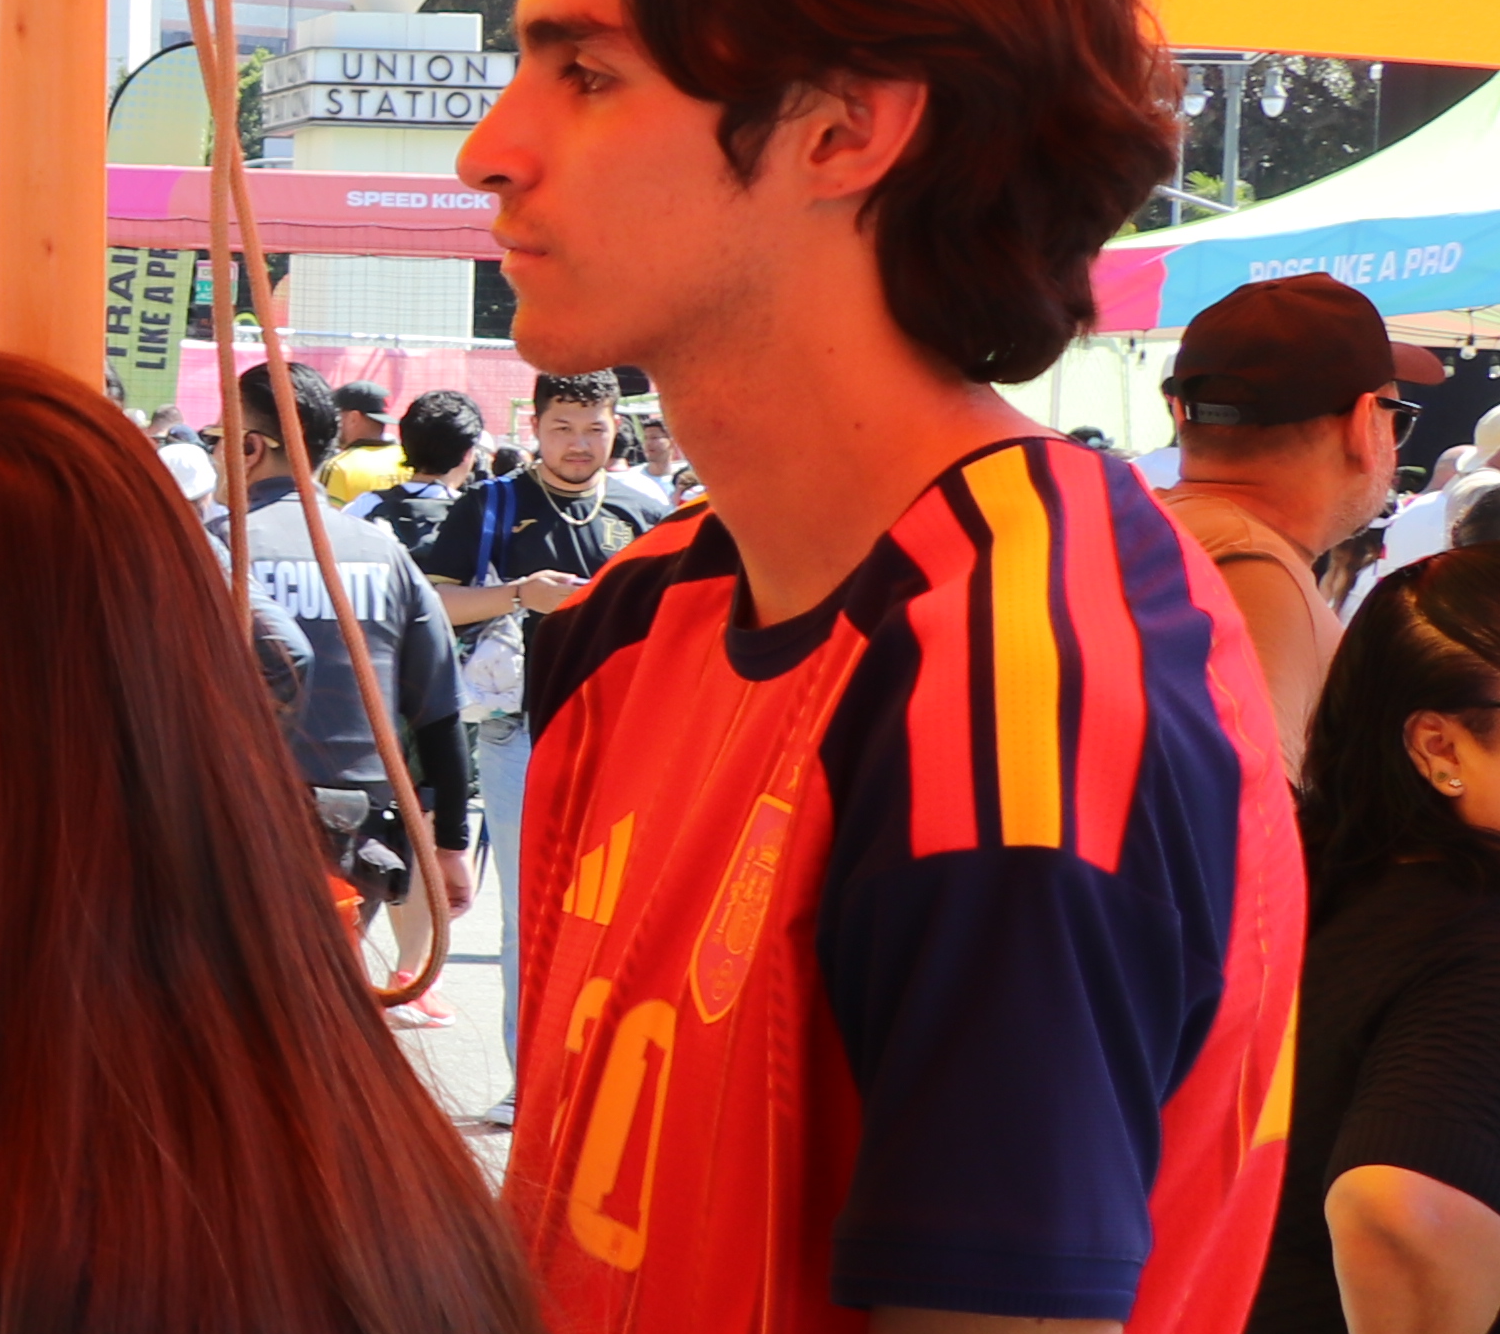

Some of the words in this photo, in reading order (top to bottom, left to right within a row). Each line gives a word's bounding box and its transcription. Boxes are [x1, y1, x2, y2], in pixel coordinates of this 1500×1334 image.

[343, 53, 488, 82] UNION
[346, 190, 428, 209] SPEED
[432, 192, 492, 210] KICK
[1376, 250, 1397, 282] A
[1402, 241, 1463, 280] PRO
[106, 246, 139, 357] TRAI
[144, 286, 175, 305] A
[136, 310, 171, 369] LIKE
